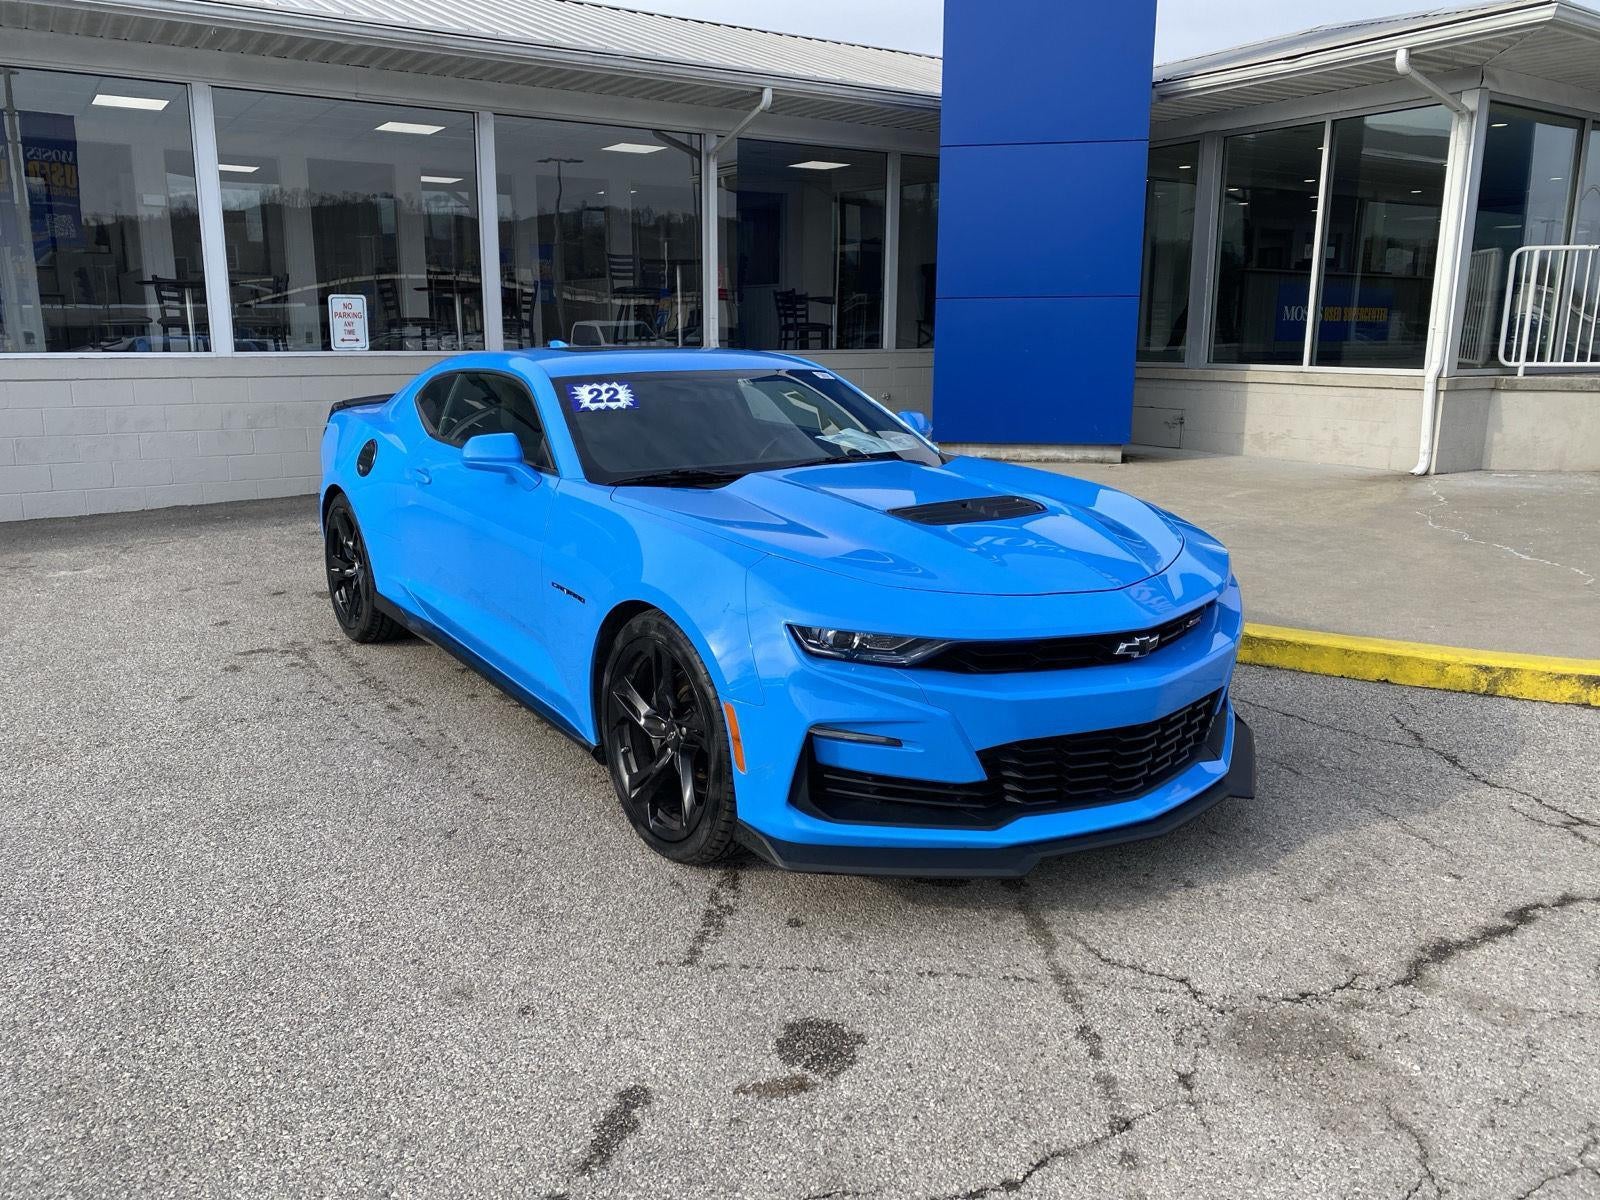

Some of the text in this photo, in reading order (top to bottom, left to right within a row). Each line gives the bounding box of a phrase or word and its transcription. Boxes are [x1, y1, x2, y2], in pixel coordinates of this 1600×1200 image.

[342, 302, 353, 310] NO
[334, 311, 363, 319] PARKING
[344, 320, 354, 328] ANY
[588, 387, 621, 404] 22
